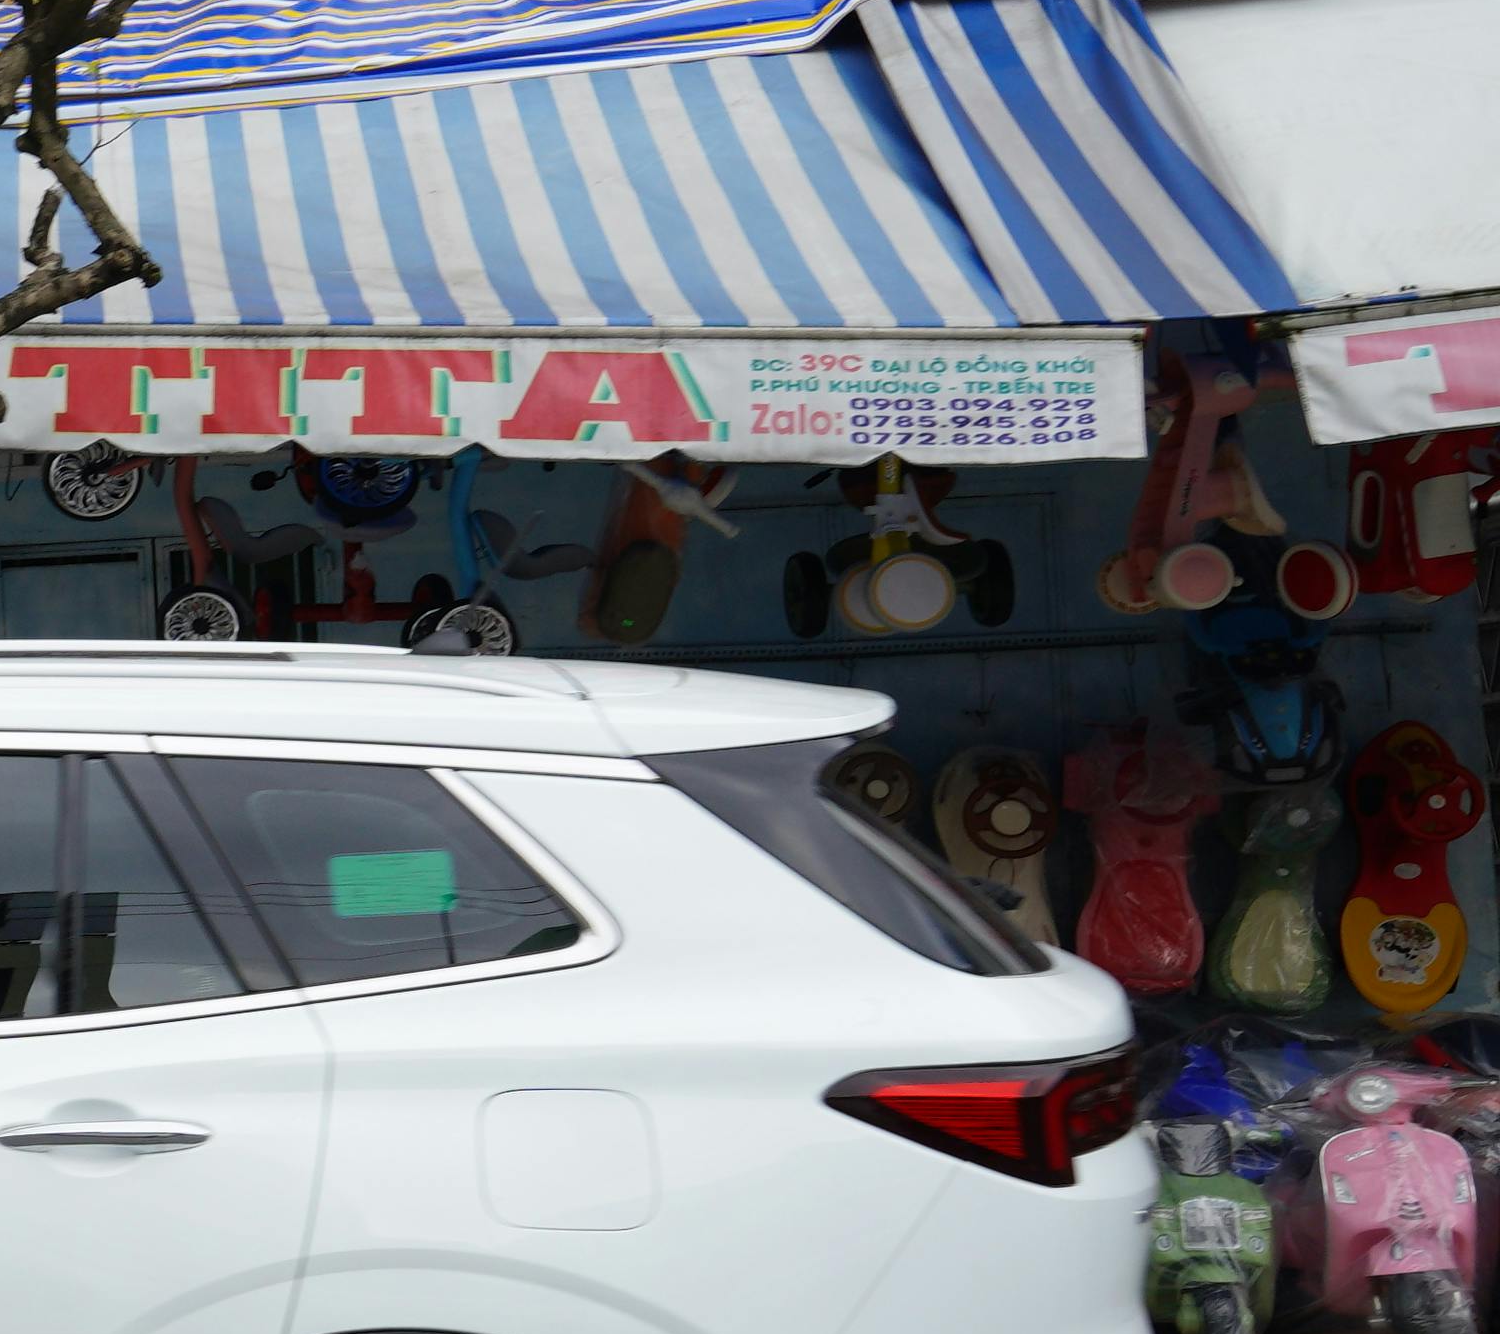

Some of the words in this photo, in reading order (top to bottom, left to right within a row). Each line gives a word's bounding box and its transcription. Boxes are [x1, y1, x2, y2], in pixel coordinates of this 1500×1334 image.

[751, 358, 792, 372] ĐC:
[800, 354, 862, 373] 39C
[872, 358, 911, 377] ĐẠI
[919, 357, 947, 377] LỘ
[956, 354, 1026, 374] ĐỒNG
[1036, 355, 1094, 374] KHỞI
[8, 345, 730, 443] TITA
[1055, 381, 1096, 394] TRE
[850, 397, 1096, 412] 0903.094.929
[751, 404, 844, 435] Zalo:
[850, 412, 1096, 428] 0785.945.678
[850, 428, 1098, 446] 0772.826.808
